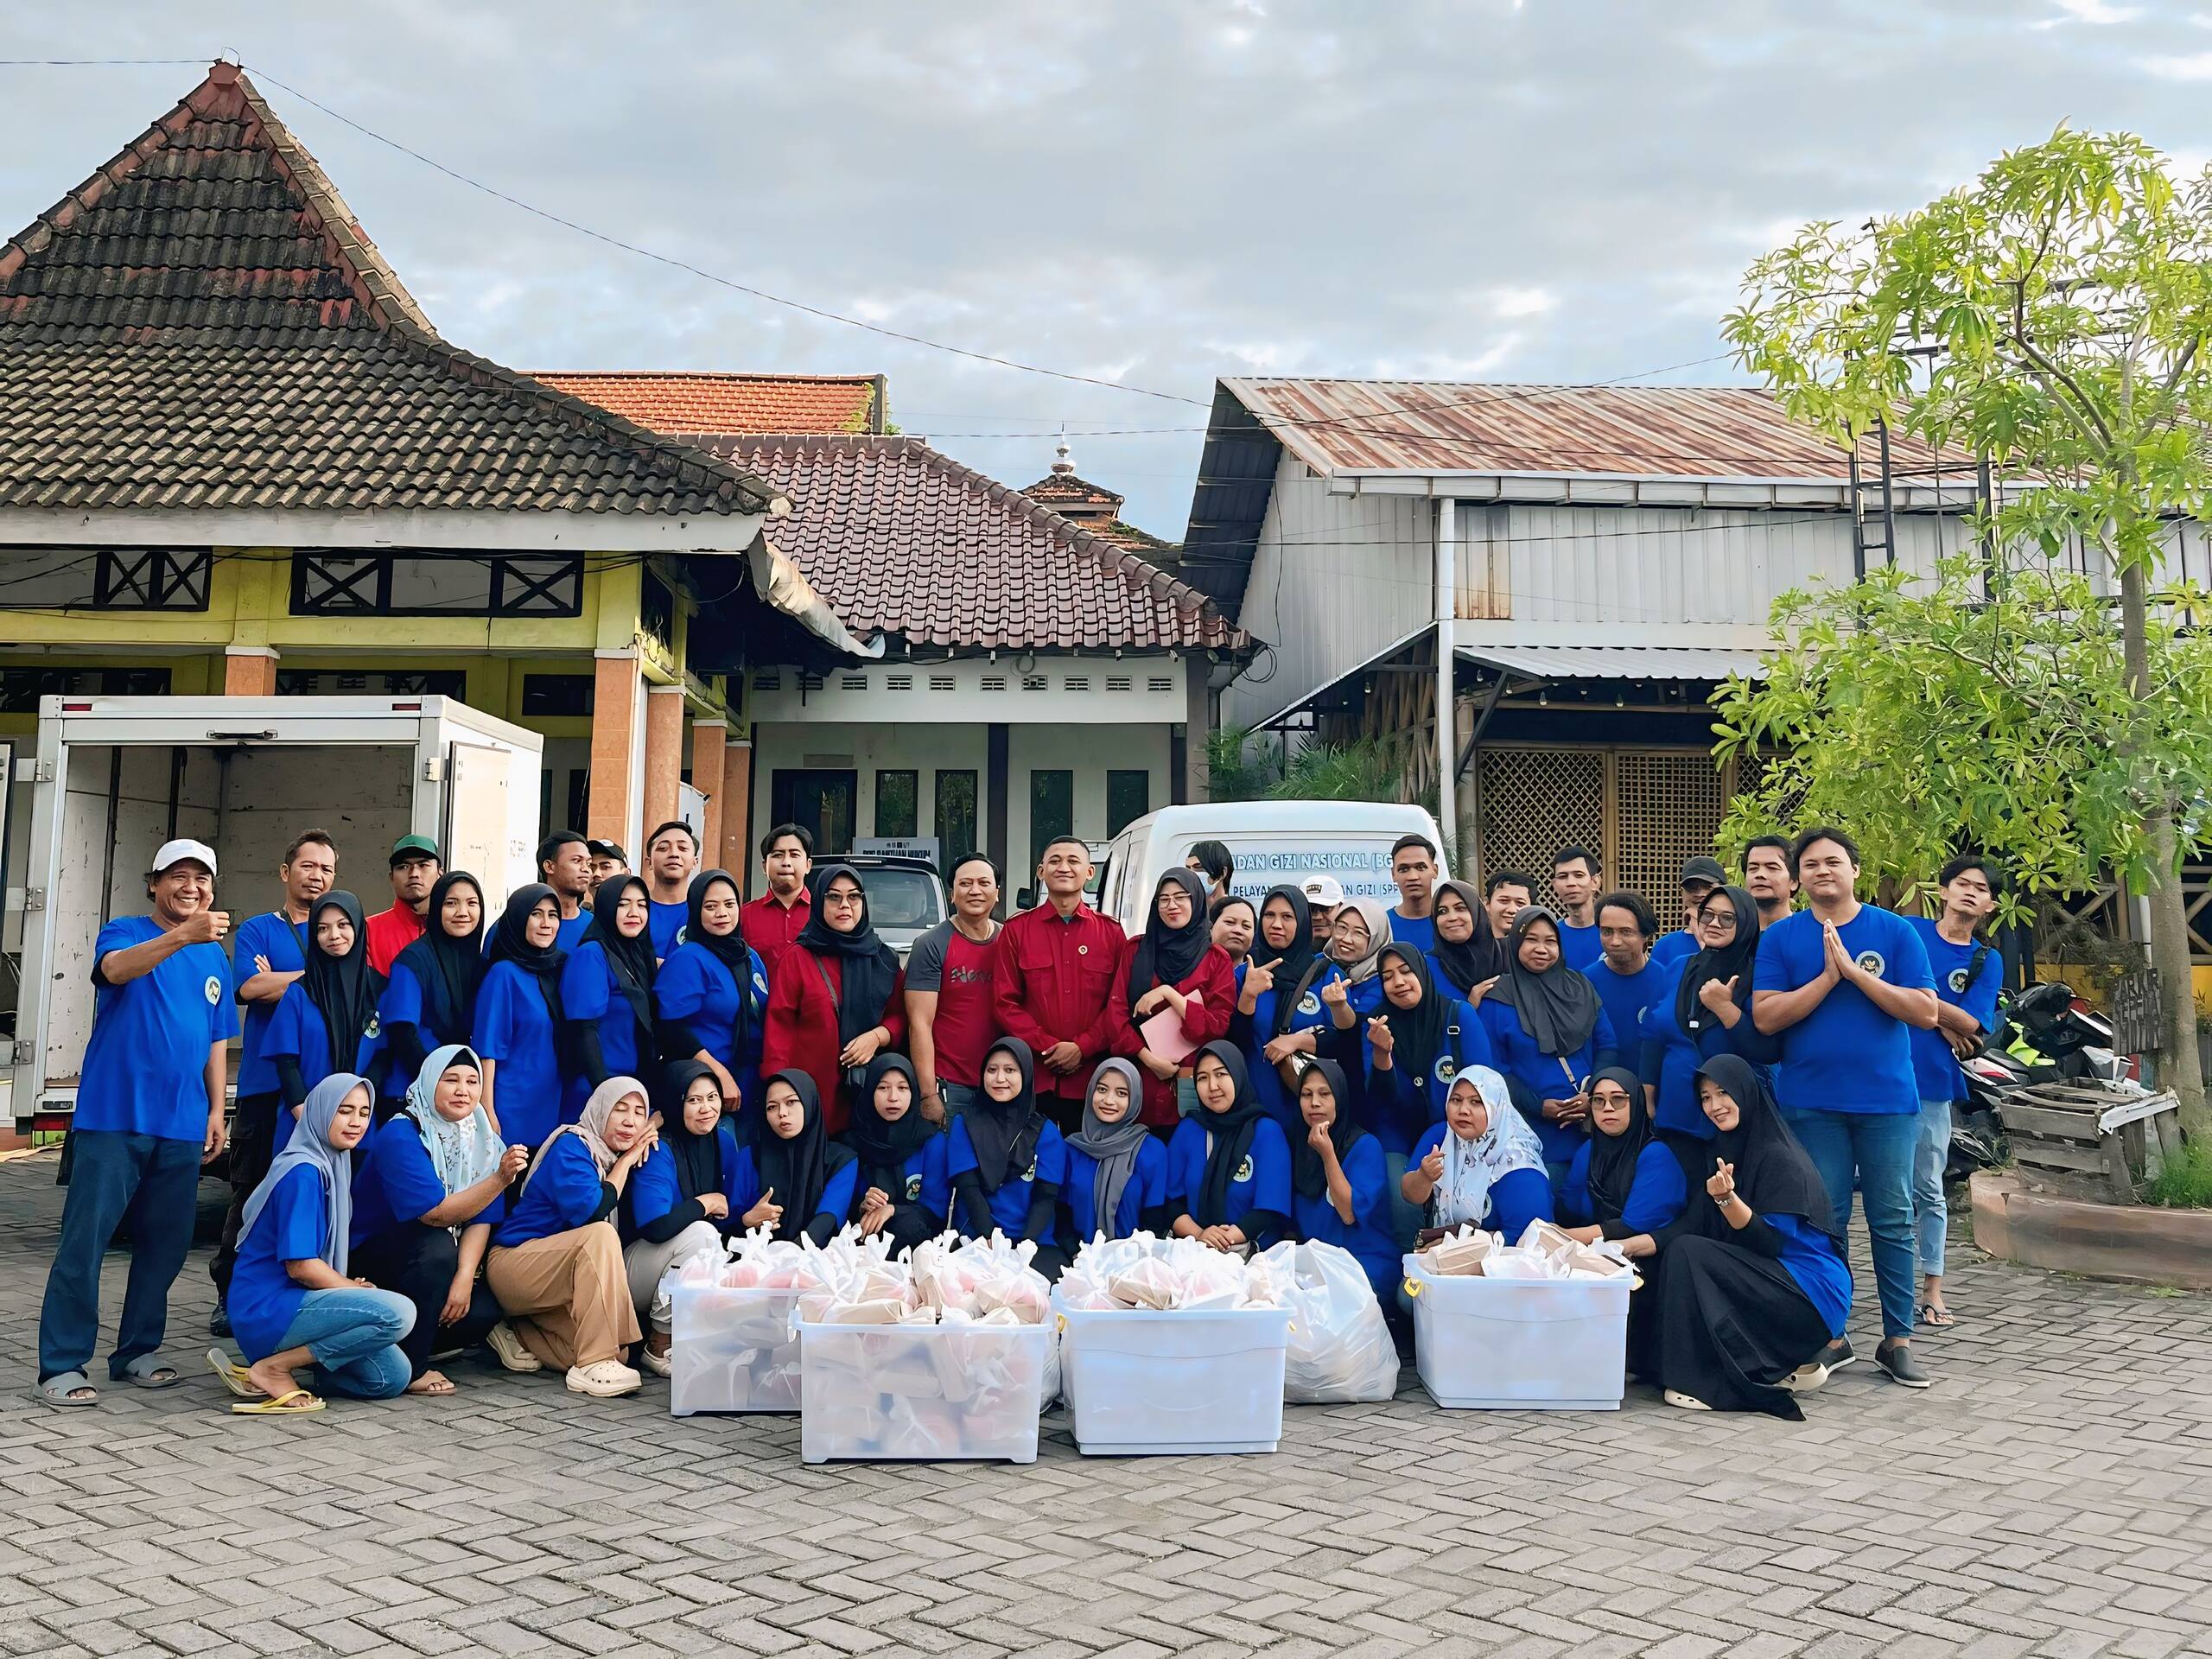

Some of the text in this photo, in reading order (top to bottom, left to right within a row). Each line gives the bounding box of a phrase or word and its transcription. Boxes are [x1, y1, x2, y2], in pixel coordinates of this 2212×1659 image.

[1269, 854, 1297, 870] GIZI
[1300, 853, 1368, 870] NASIONAL
[1356, 884, 1376, 895] GIZI
